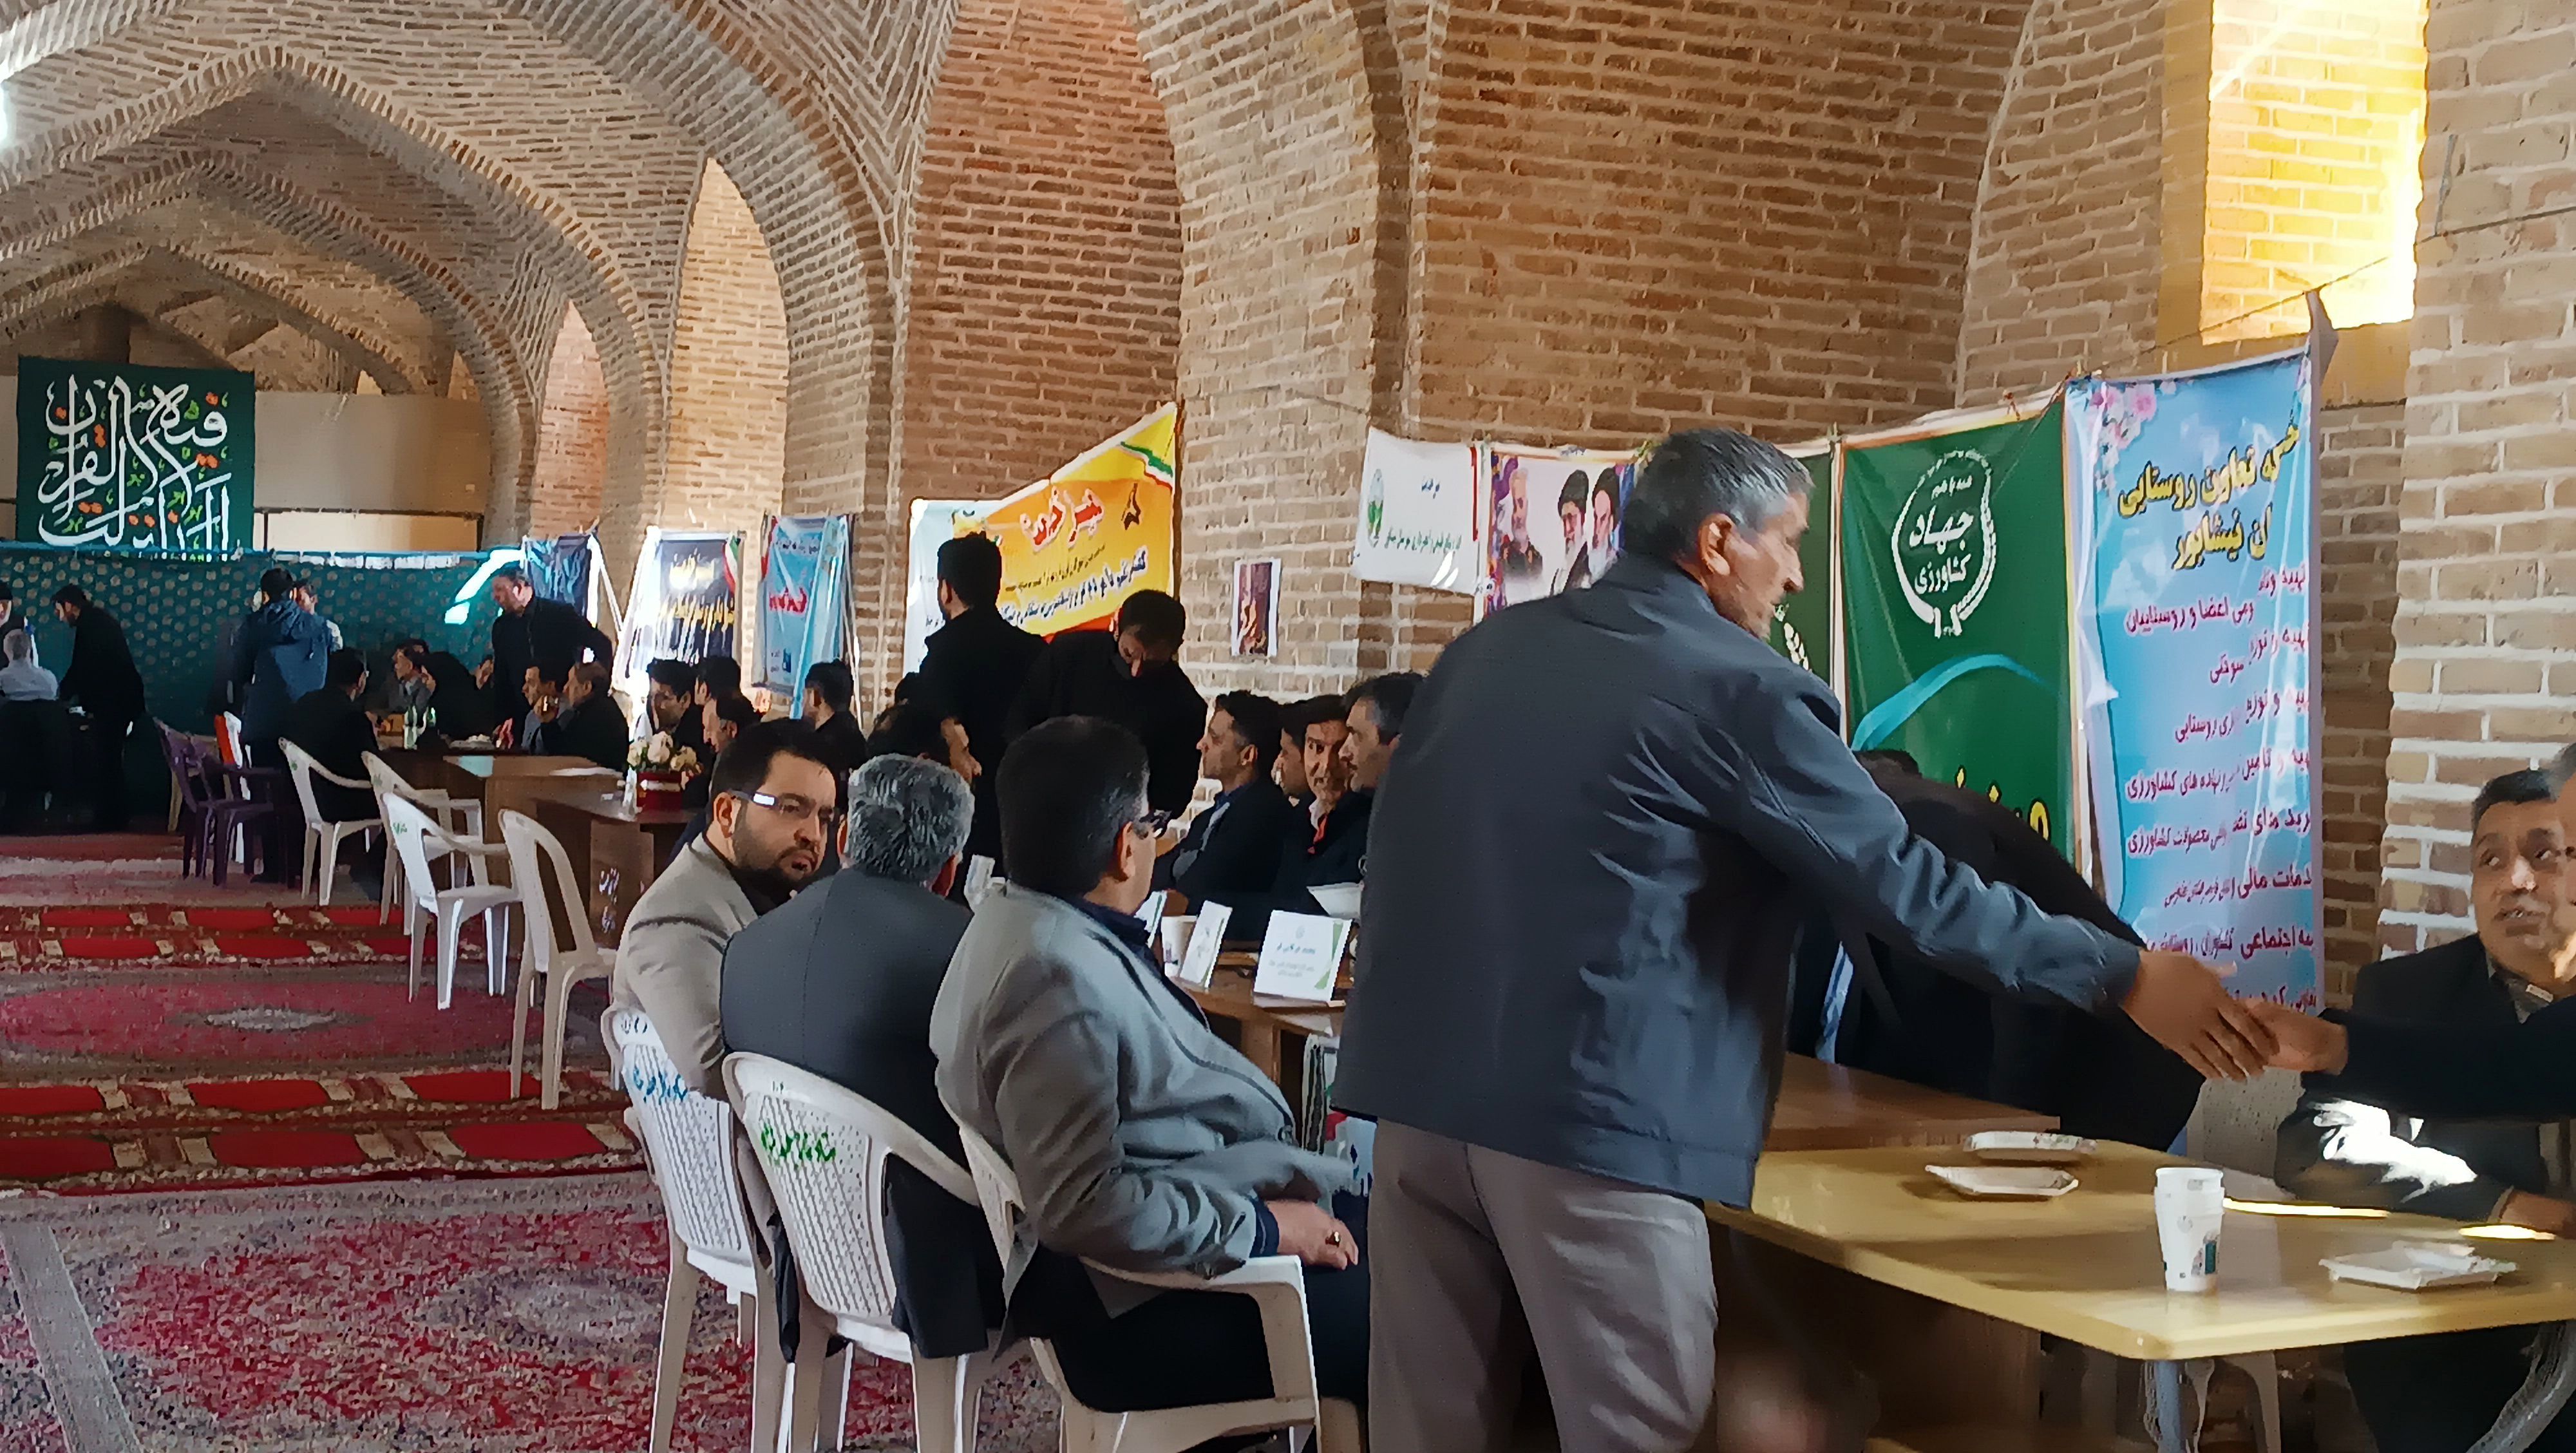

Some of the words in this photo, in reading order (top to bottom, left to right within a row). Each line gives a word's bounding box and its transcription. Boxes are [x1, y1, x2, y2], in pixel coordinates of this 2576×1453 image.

[2117, 461, 2197, 518] روستایی
[1909, 504, 1975, 555] جهاد
[2171, 507, 2245, 571] نیشابور
[1914, 552, 1972, 594] کشاورزی
[2189, 607, 2197, 630] و
[2199, 596, 2229, 620] اعضا
[2128, 770, 2177, 801] کشاورزی
[2237, 866, 2268, 899] مالی
[2240, 925, 2297, 961] اجتماعی
